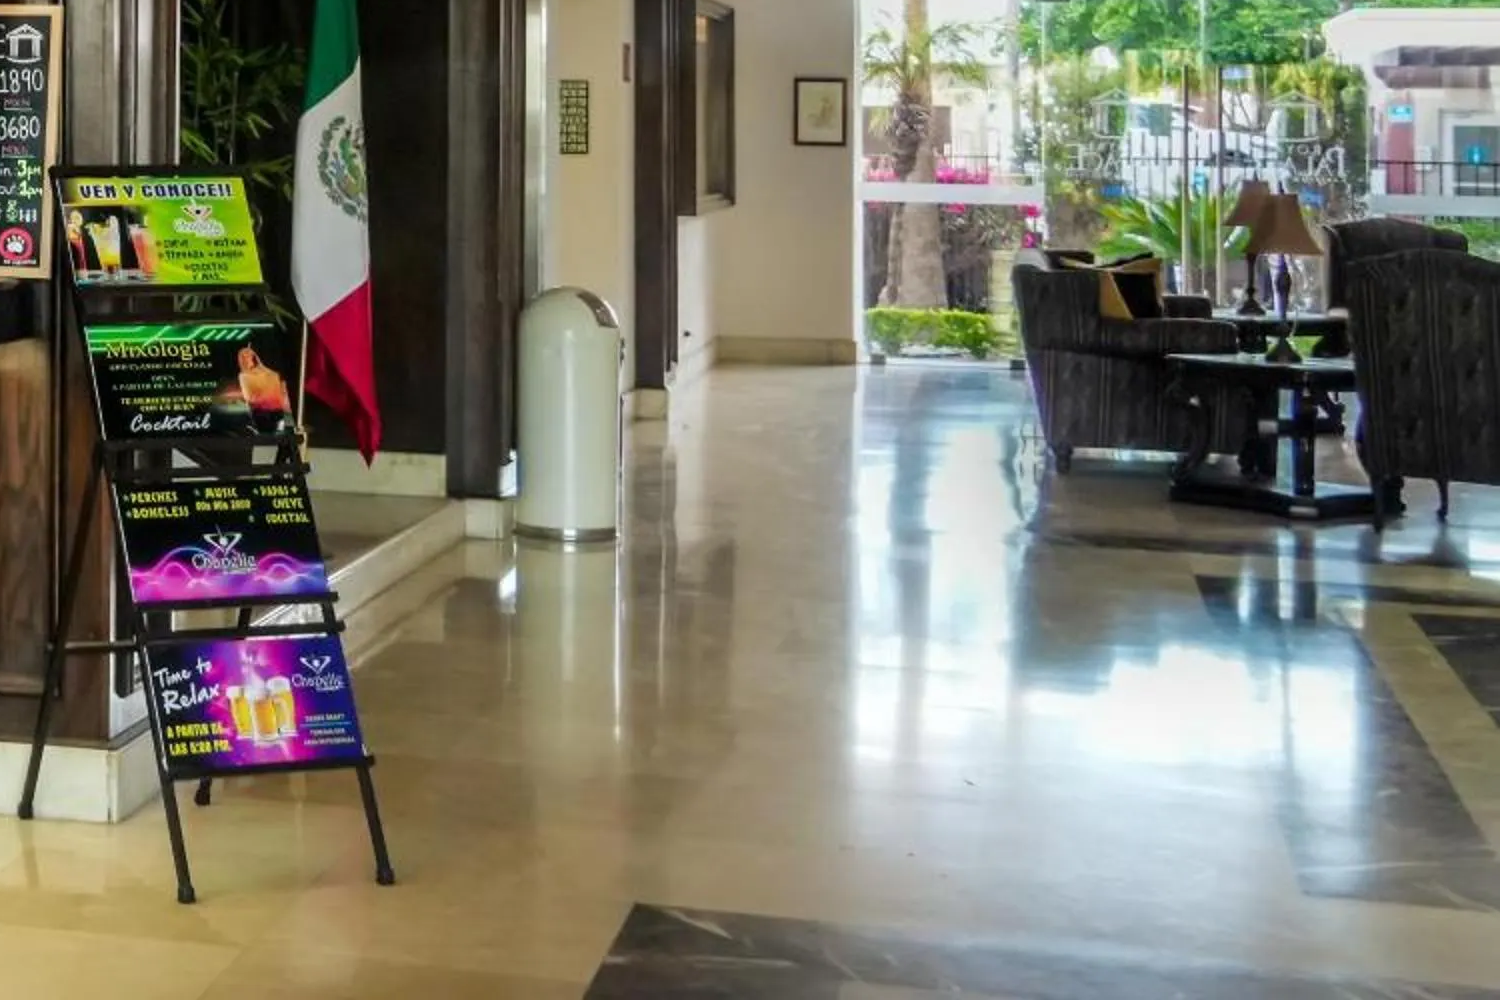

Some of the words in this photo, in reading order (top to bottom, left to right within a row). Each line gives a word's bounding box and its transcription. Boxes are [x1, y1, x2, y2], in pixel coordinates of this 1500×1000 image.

[79, 184, 118, 199] VEN
[122, 184, 134, 198] Y
[130, 412, 211, 434] Cocktail
[132, 506, 189, 519] BONELESS
[153, 665, 192, 689] Time
[195, 655, 213, 677] to
[161, 682, 221, 716] Relax
